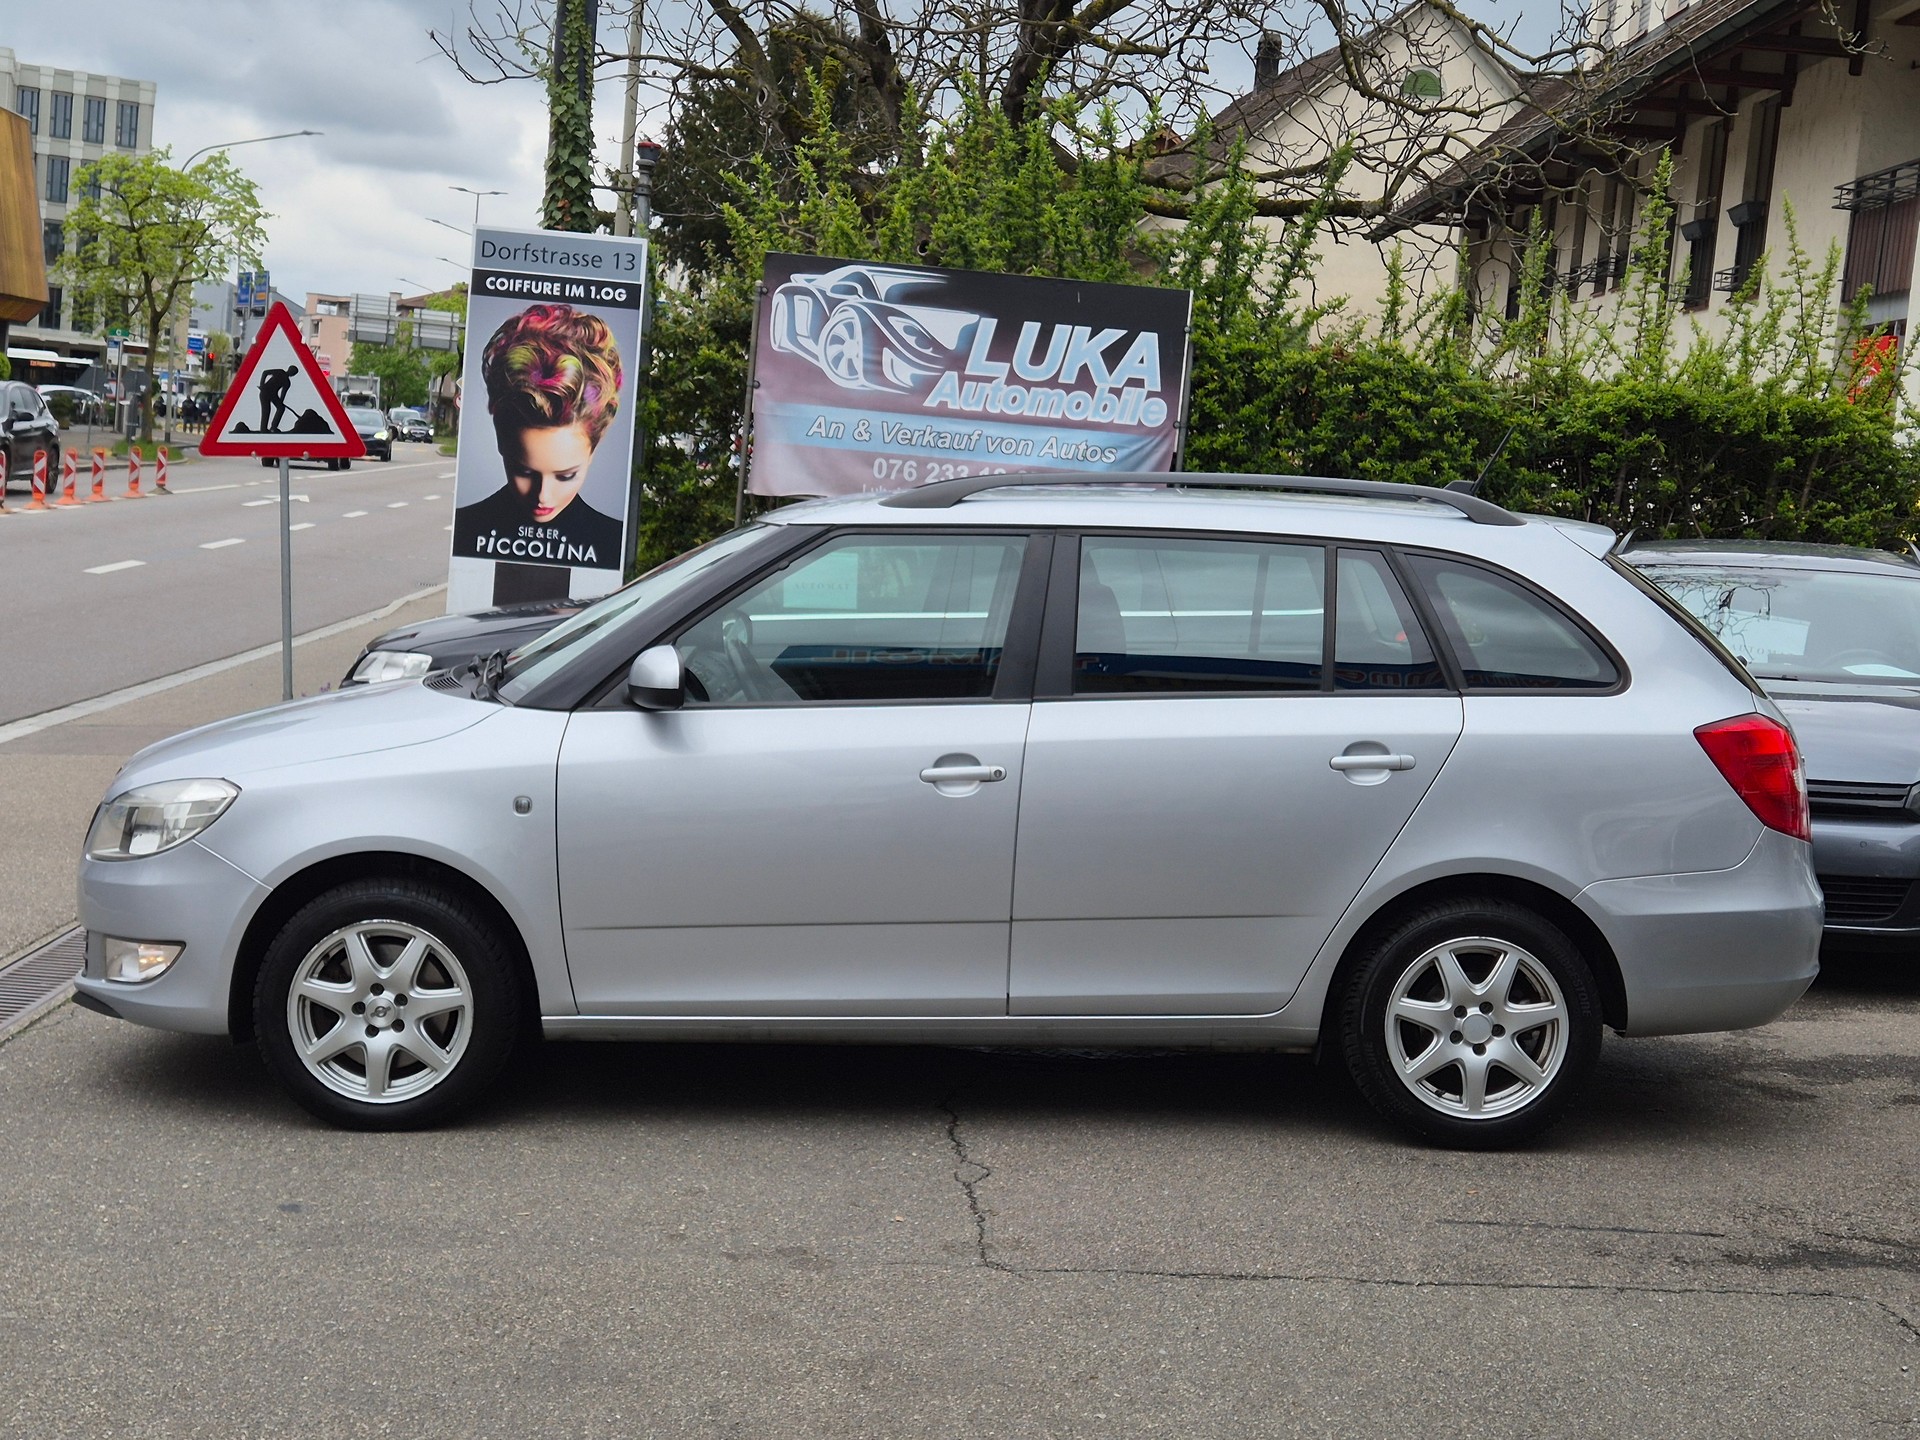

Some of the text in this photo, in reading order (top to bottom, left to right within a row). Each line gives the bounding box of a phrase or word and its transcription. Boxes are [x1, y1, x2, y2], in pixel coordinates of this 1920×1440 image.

[481, 240, 636, 271] Dorfstrasse 13
[485, 276, 627, 302] COIFFURE IM 1.OG
[964, 317, 1162, 392] LUKA
[923, 370, 1168, 428] Automobile
[806, 415, 1118, 465] An & Verkauf von Autos
[872, 457, 918, 482] 076
[518, 526, 559, 540] SIE & ER
